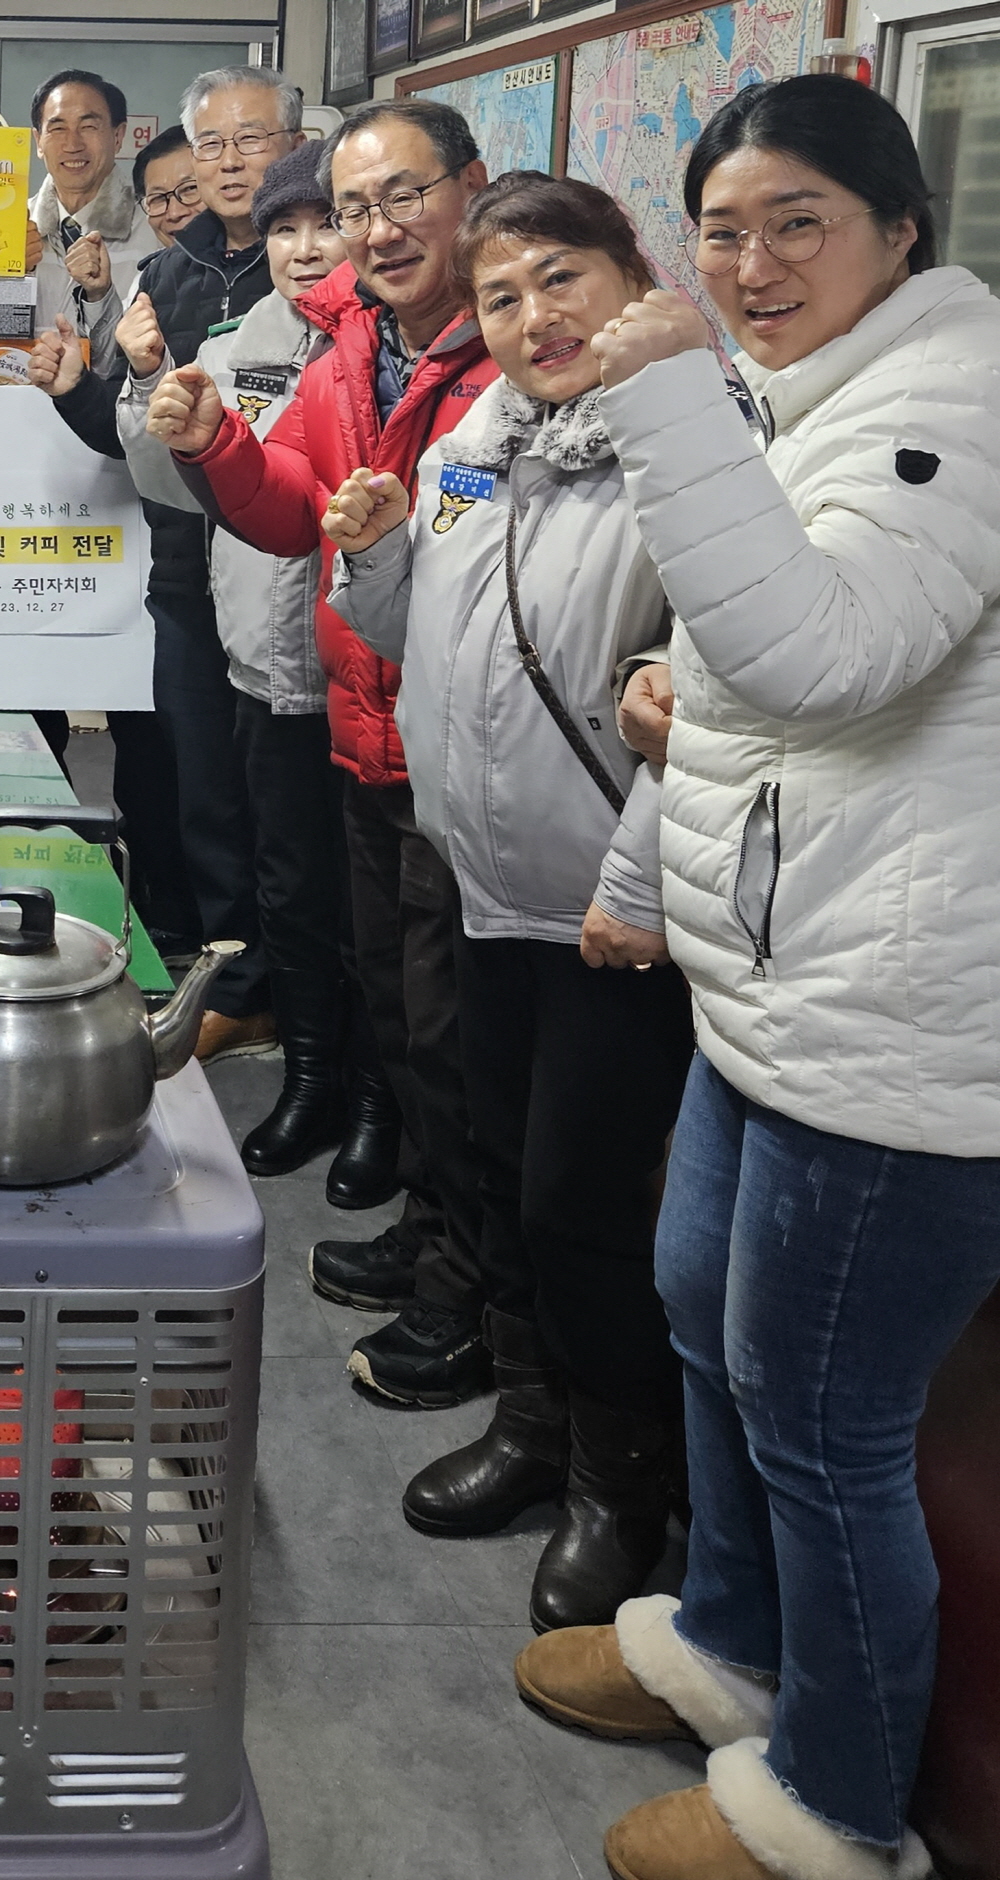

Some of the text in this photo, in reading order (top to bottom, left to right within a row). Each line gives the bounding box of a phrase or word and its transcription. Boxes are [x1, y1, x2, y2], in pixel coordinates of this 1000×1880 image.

[7, 260, 22, 269] 170
[2, 502, 91, 520] 행복하세요
[20, 535, 58, 554] 커피
[72, 535, 113, 557] 전달
[11, 577, 97, 596] 주민자치회
[27, 603, 44, 612] 12.
[50, 603, 64, 612] 27
